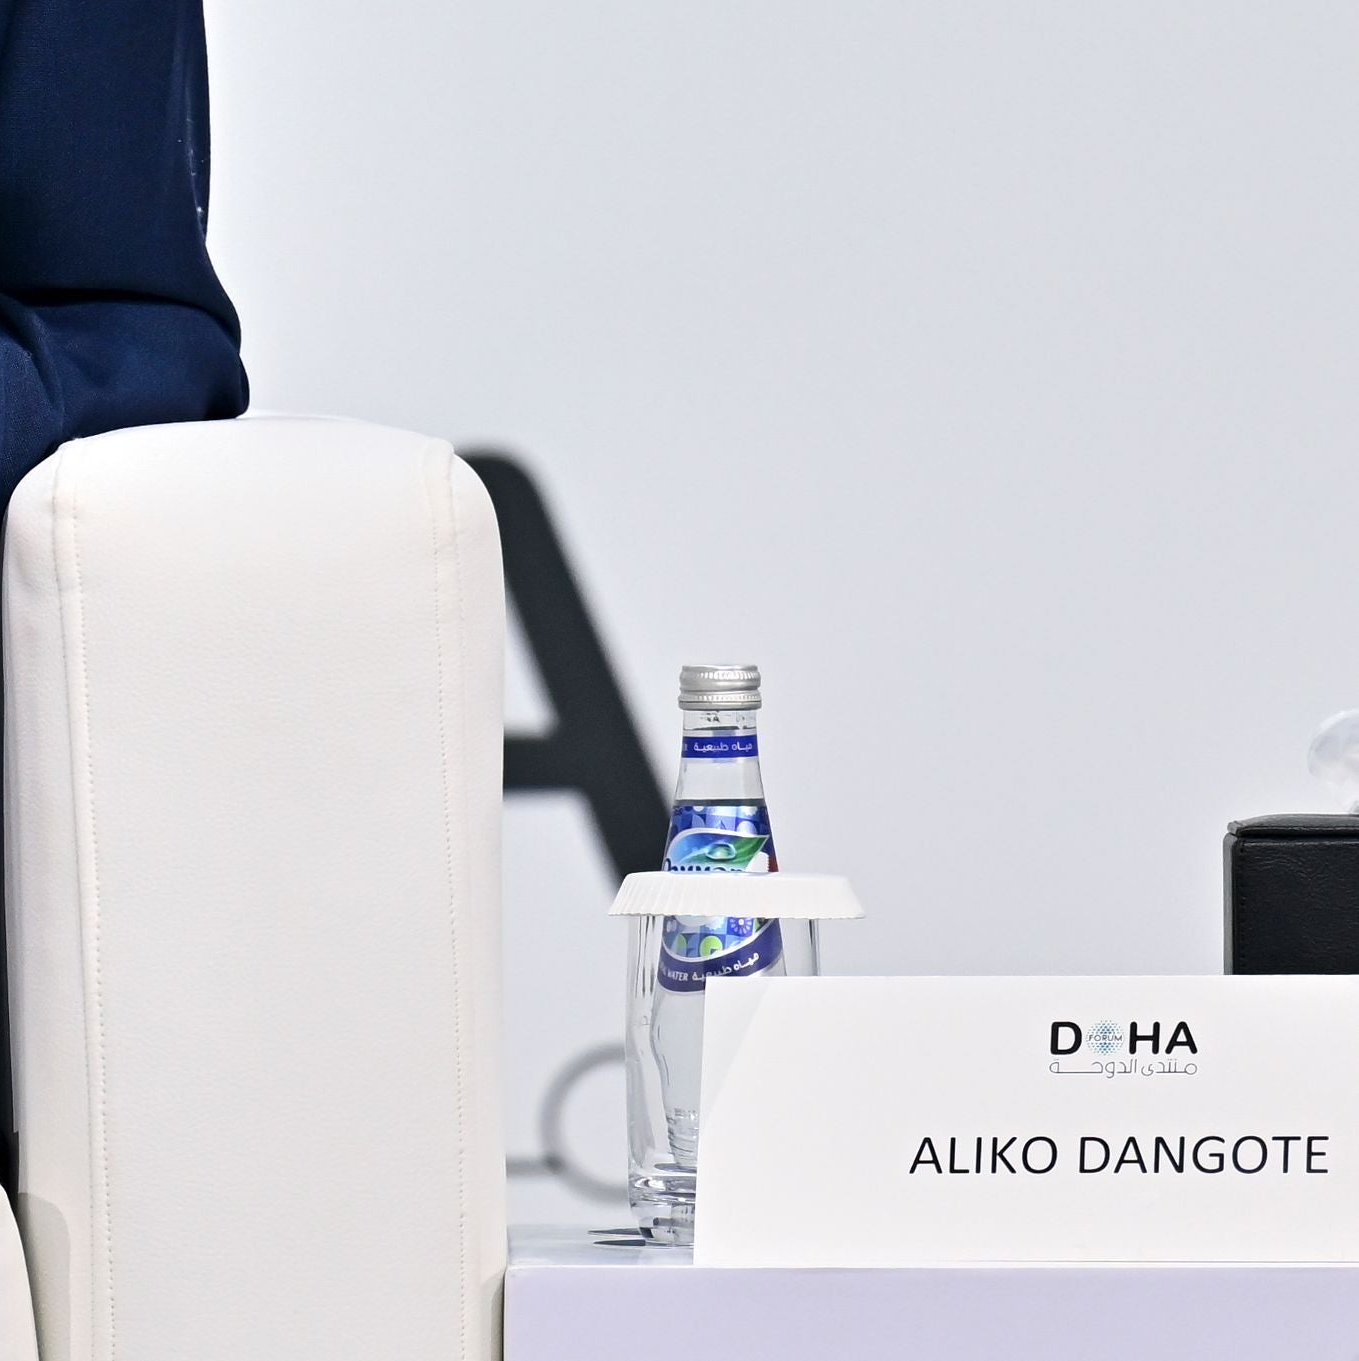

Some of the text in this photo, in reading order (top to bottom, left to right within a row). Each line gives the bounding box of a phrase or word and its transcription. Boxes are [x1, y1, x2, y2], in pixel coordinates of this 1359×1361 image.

[1088, 1034, 1123, 1042] FORUM
[908, 1135, 1330, 1175] ALIKO DANGOTE
